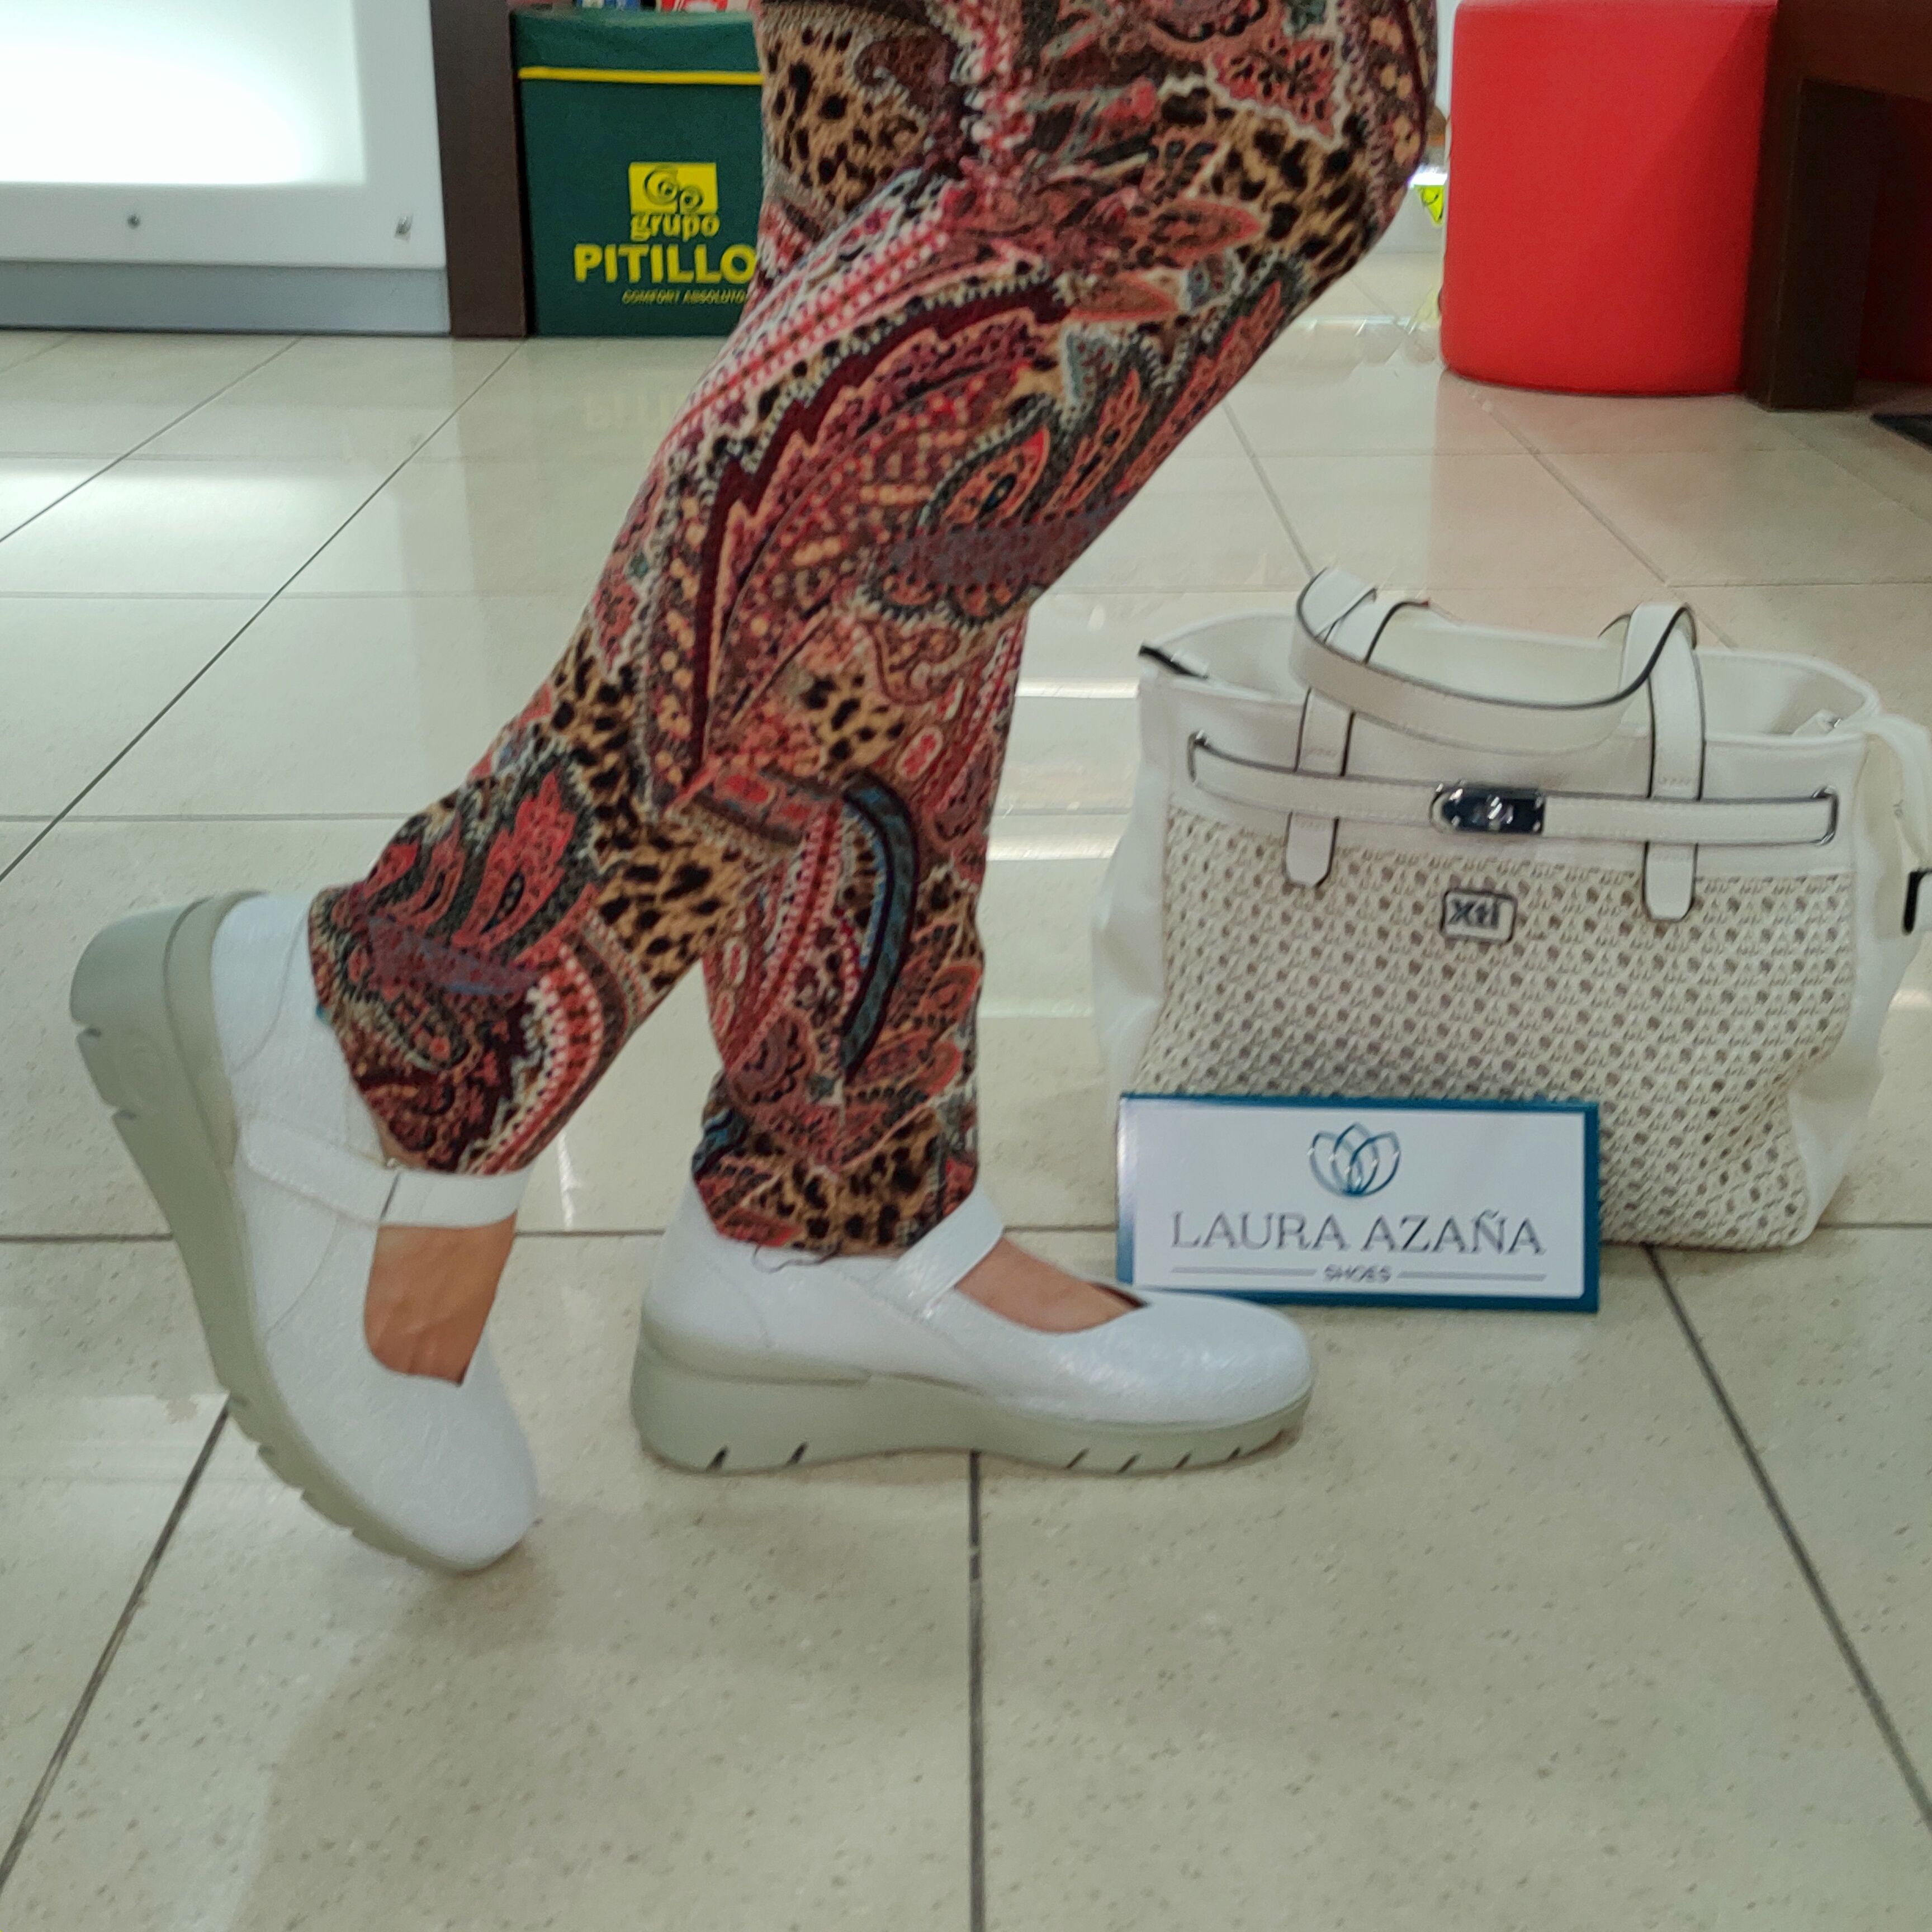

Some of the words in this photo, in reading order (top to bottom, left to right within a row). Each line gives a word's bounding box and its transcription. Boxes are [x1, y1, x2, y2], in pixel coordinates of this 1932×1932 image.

[630, 214, 720, 242] grupo
[1171, 1210, 1351, 1252] LAURA
[1360, 1209, 1547, 1256] AZAÑA
[1323, 1263, 1392, 1284] SHOES
